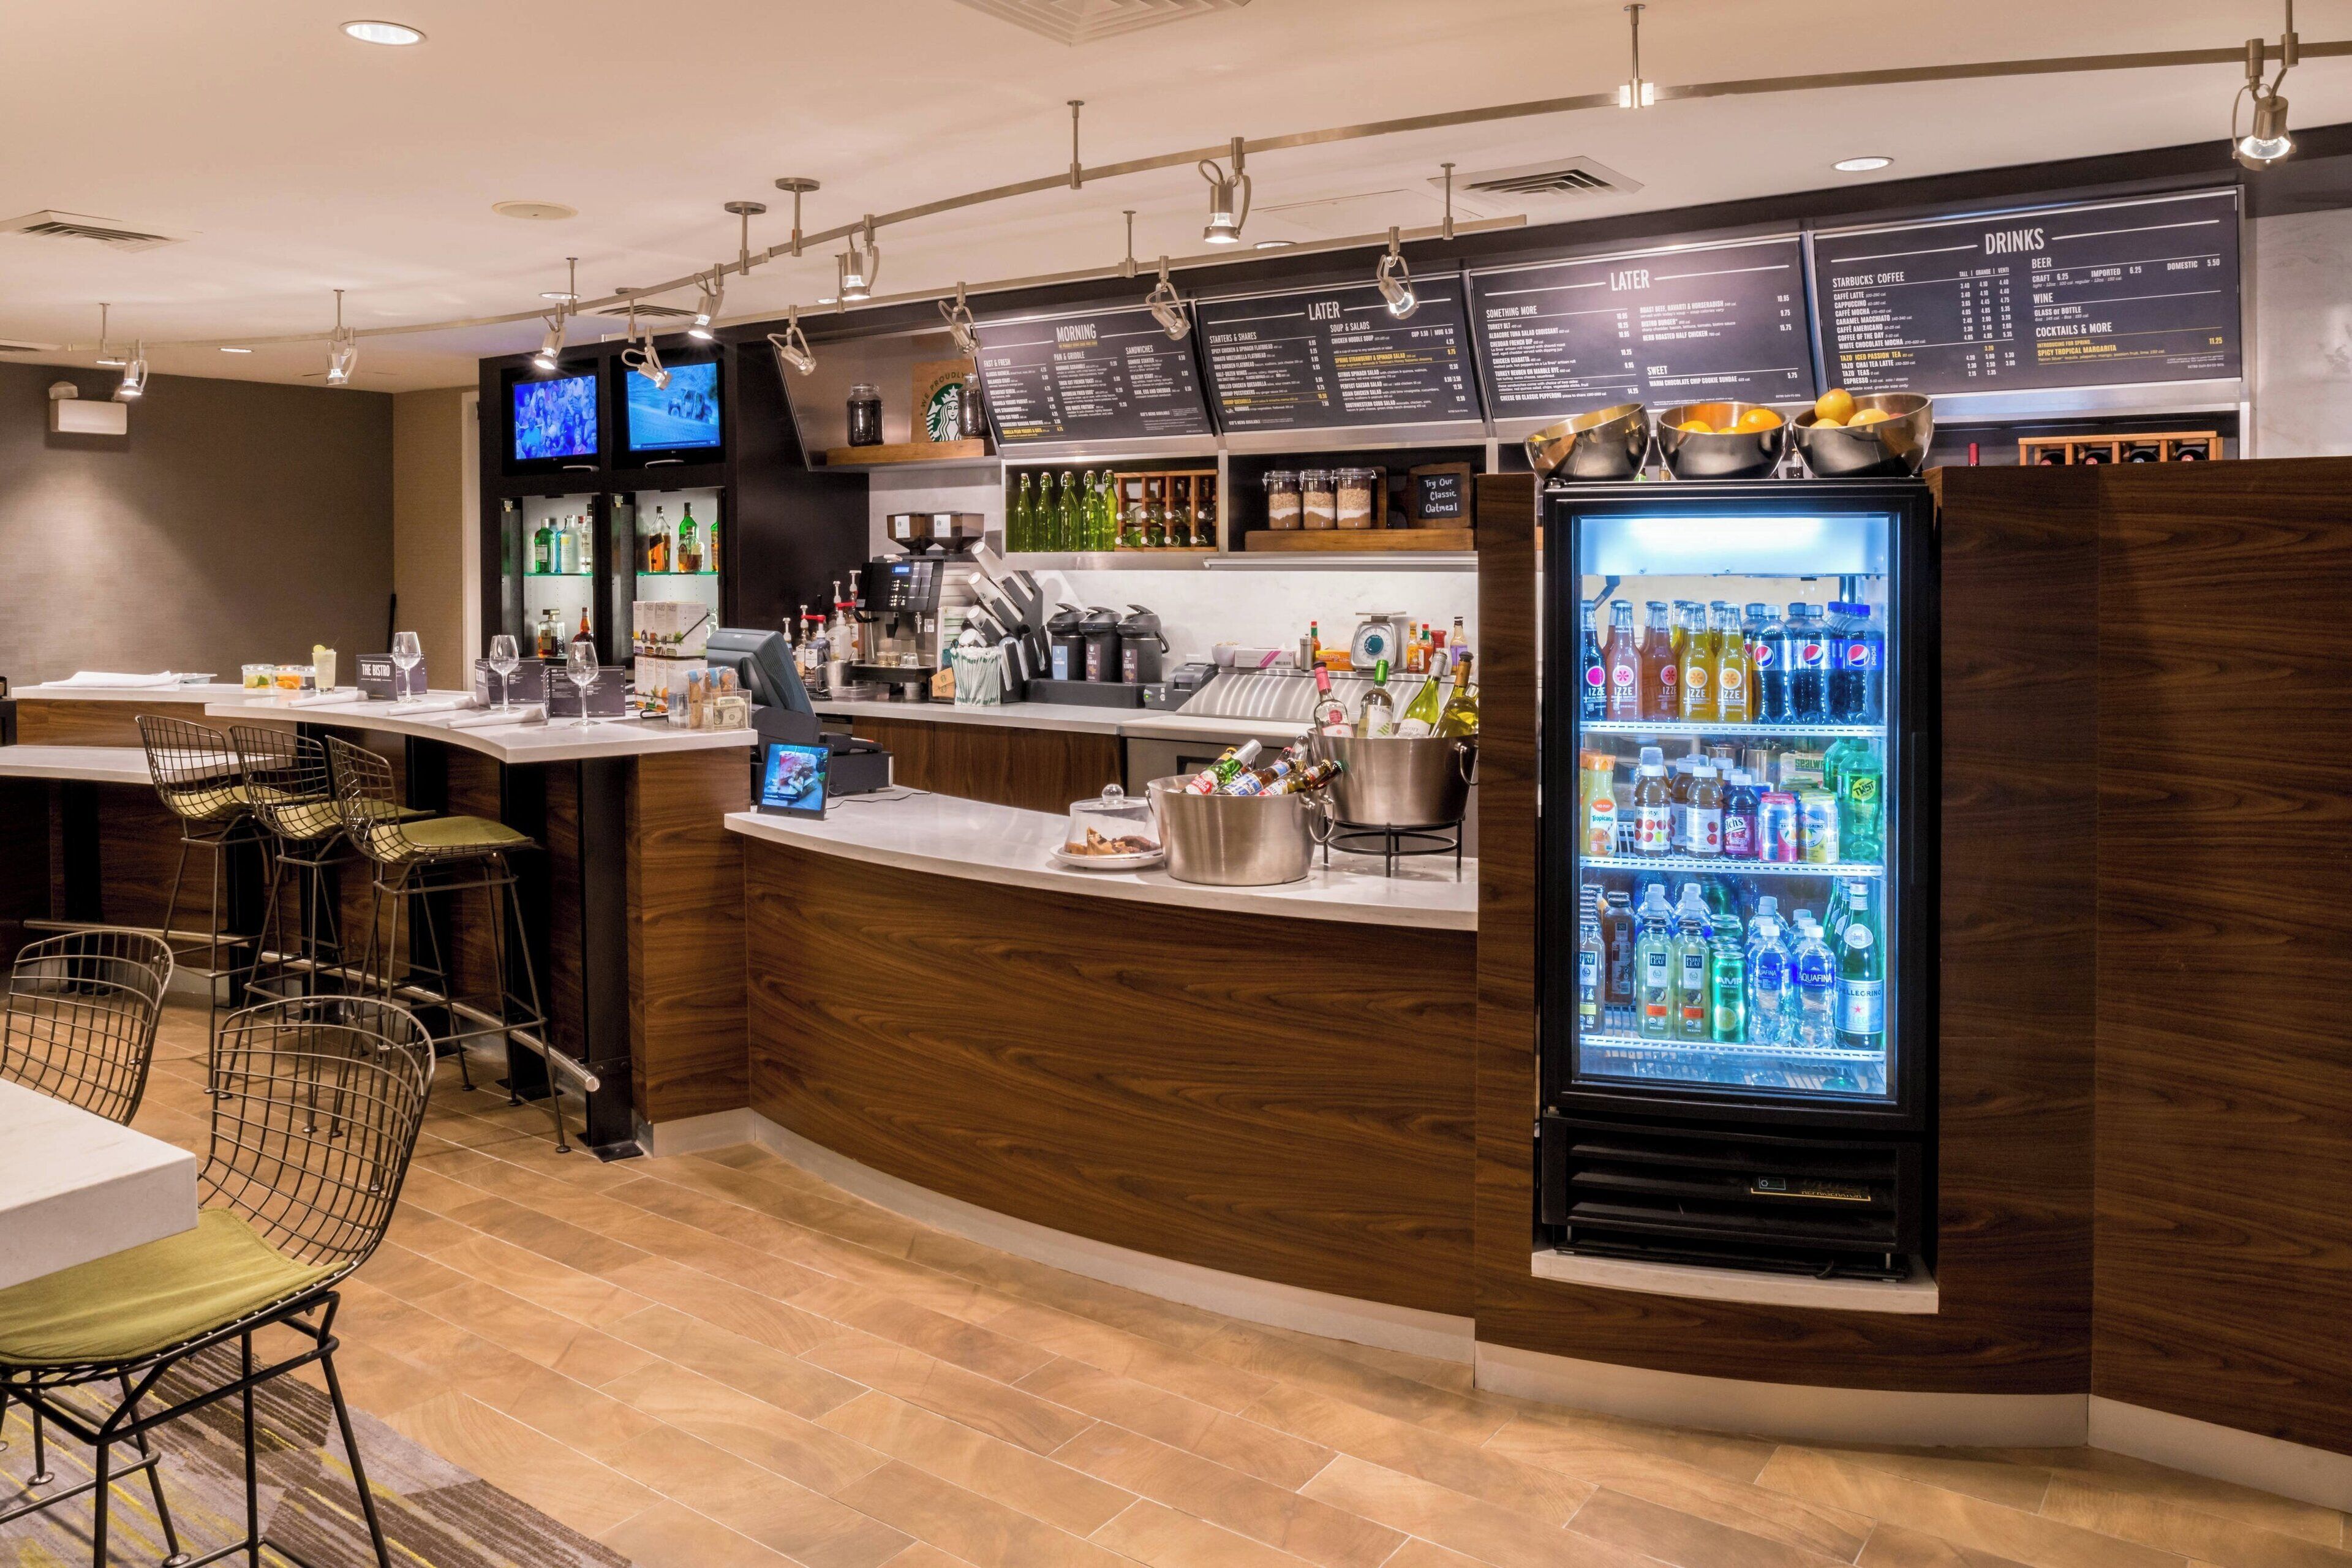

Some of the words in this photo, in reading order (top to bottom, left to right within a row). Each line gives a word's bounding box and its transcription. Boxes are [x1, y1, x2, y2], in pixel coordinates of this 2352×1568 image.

[1985, 228, 2045, 254] DRINKS
[2032, 257, 2051, 268] BEER
[2091, 268, 2120, 277] IMPORTED
[2167, 261, 2198, 270] DOMESTIC
[1610, 270, 1649, 291] LATER
[1833, 275, 1873, 287] STARBUCKS
[1878, 272, 1905, 284] COFFEE
[2034, 293, 2054, 304] WINE
[1834, 300, 1866, 309] CAPPUCCINO
[1308, 301, 1341, 320] LATER
[1486, 307, 1519, 318] SOMETHING
[1521, 306, 1537, 315] MORE
[1861, 315, 1890, 323] MACCHIATO
[1057, 323, 1096, 342] MORNING
[1330, 324, 1343, 333] SOUP
[1350, 322, 1370, 331] SALADS
[1853, 324, 1883, 333] AMERICANO
[2036, 325, 2078, 337] COCKTAILS
[2081, 324, 2087, 333] &
[2089, 322, 2112, 333] MORE
[1210, 334, 1232, 344] STARTERS
[1238, 332, 1257, 341] SHARES
[1126, 345, 1154, 355] SANDWICHES
[2083, 345, 2117, 353] MARGARITA
[1068, 351, 1085, 360] GRIDDLE
[1647, 366, 1668, 375] SWEET
[921, 393, 930, 407] WE
[930, 372, 965, 390] PROUDLY
[1424, 480, 1436, 489] Try
[1430, 489, 1457, 500] Classic
[1426, 502, 1457, 513] Oatmeal
[362, 664, 371, 676] THE
[372, 665, 390, 676] BISTRO
[1588, 687, 1605, 696] IZZE
[1726, 818, 1743, 829] lch's
[1799, 973, 1832, 983] AQUAFINA
